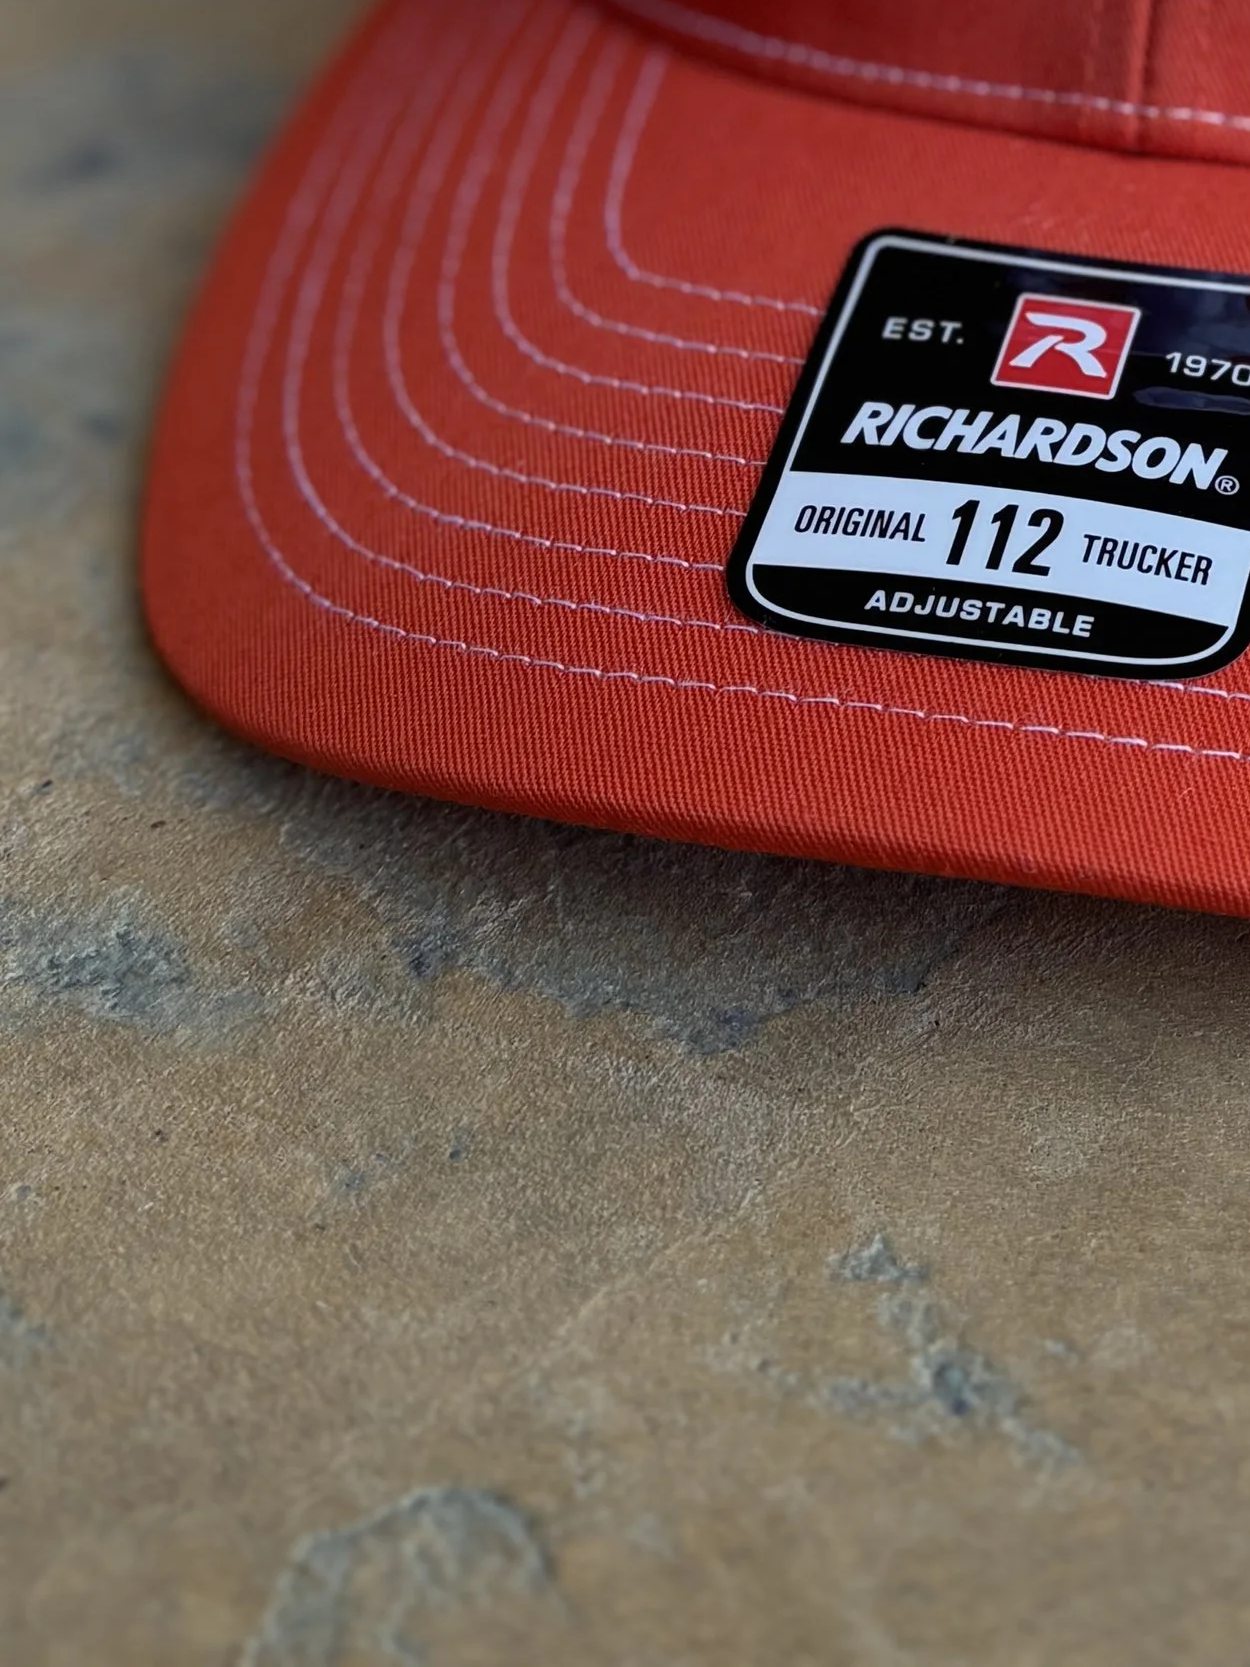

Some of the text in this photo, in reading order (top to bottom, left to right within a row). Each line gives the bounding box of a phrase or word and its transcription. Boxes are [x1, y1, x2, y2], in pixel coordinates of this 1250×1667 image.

[881, 316, 966, 345] EST.
[1008, 309, 1109, 379] R
[793, 498, 1214, 587] ORIGINAL 112 TRUCKER
[863, 589, 1096, 638] ADJUSTABLE
